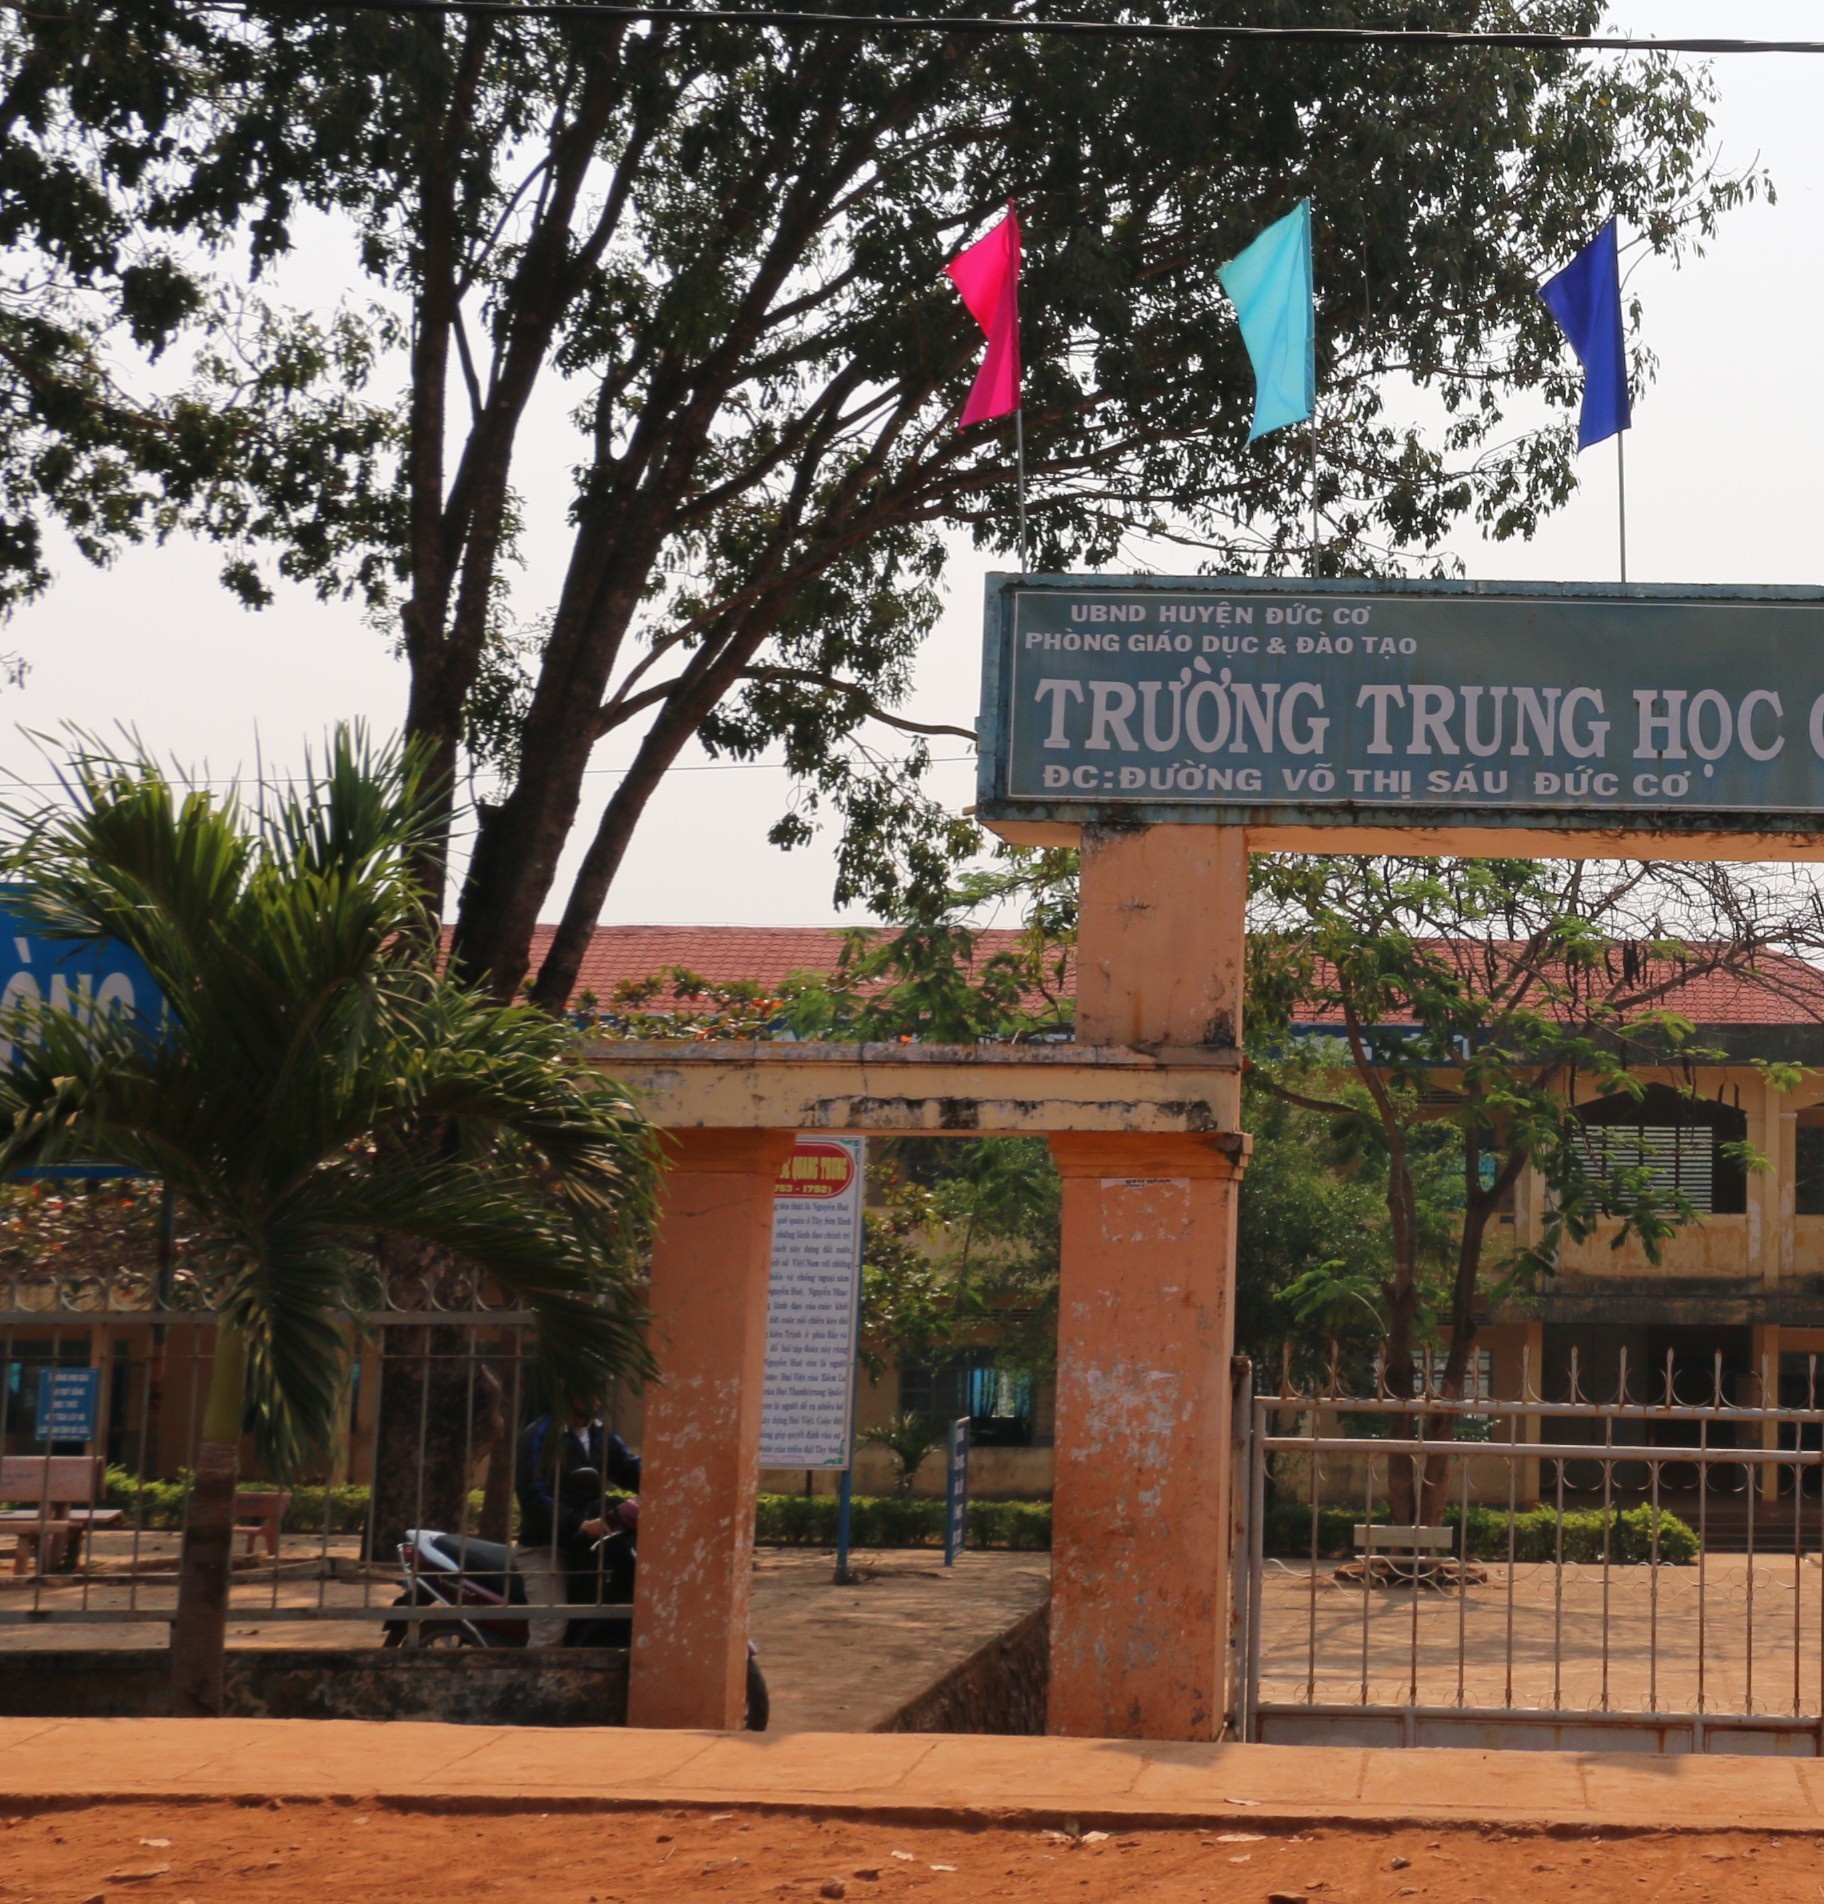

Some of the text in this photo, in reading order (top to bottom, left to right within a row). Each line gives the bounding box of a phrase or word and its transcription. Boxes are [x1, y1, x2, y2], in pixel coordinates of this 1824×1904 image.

[1071, 602, 1371, 626] UBND HUYỆN ĐỨC CƠ
[1025, 629, 1417, 659] PHÒNG GIÁO DỤC & ĐÀO TẠO
[1034, 656, 1330, 755] TRƯỜNG
[1356, 684, 1611, 758] TRUNG
[1632, 689, 1785, 778] HỌC
[1282, 763, 1335, 792] VÕ
[1346, 769, 1411, 801] THỊ
[1427, 762, 1508, 794] SÁU
[1533, 764, 1619, 796] ĐỨC
[1633, 770, 1691, 797] CƠ
